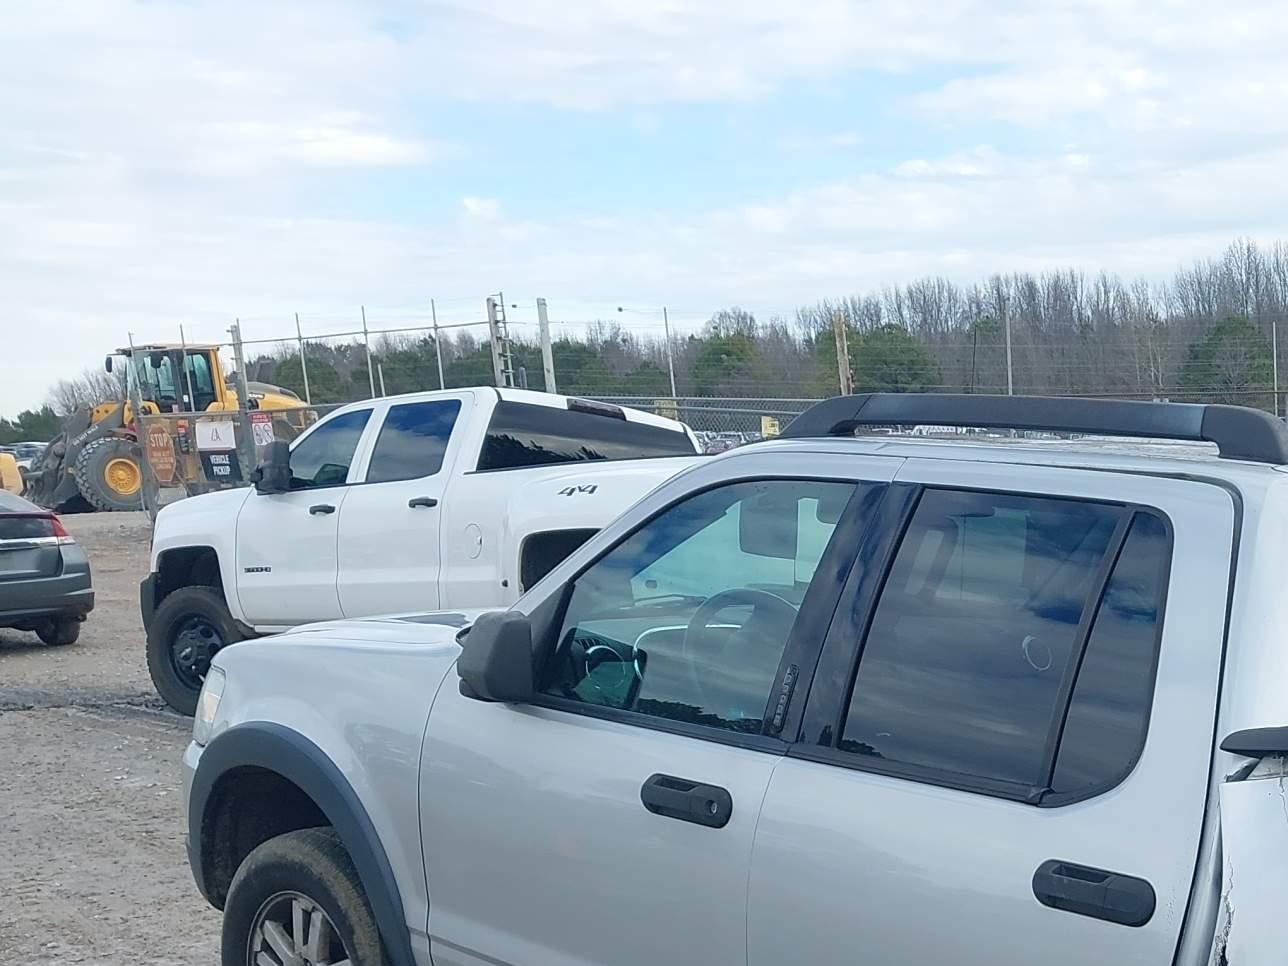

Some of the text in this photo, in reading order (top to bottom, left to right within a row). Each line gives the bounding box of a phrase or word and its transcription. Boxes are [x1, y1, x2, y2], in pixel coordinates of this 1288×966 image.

[150, 433, 168, 447] STOP
[209, 454, 230, 465] VEHICLE
[212, 465, 231, 476] PICKUP
